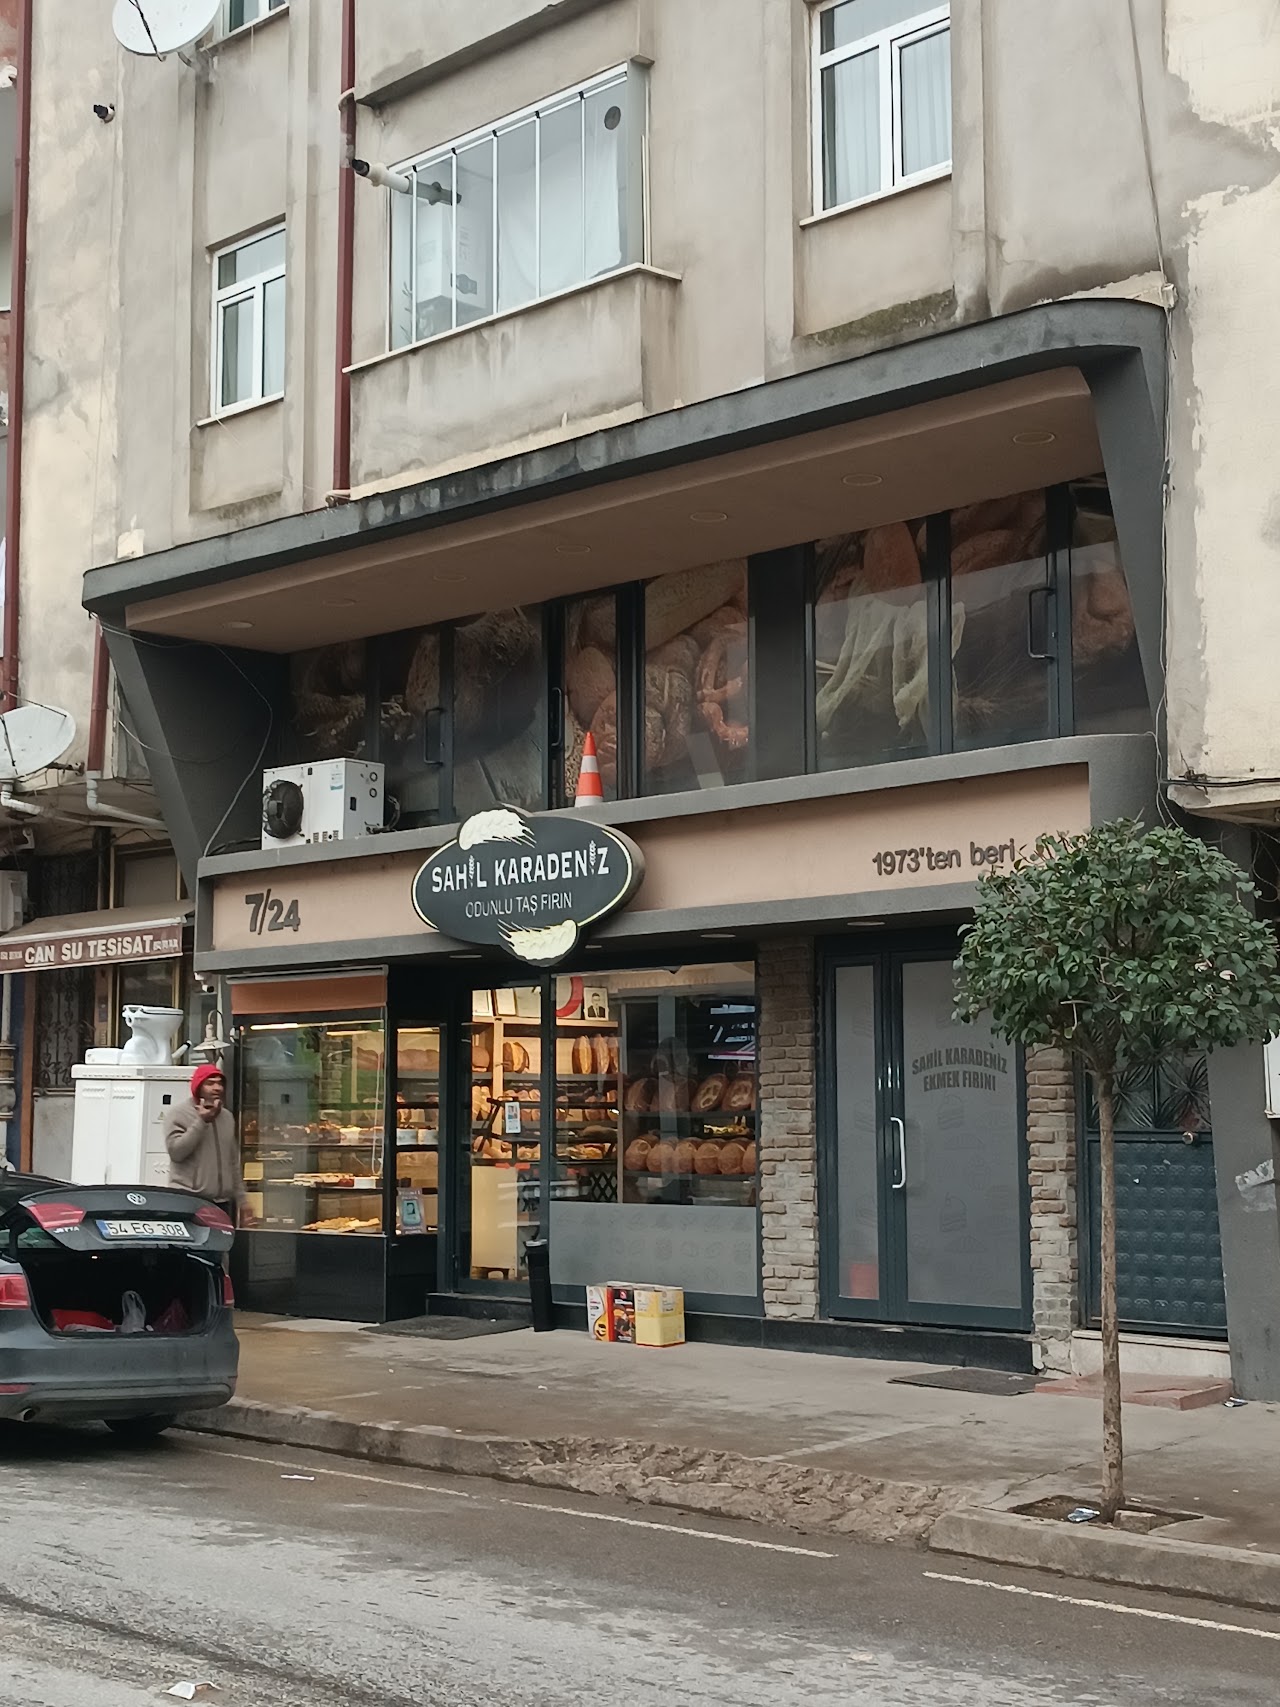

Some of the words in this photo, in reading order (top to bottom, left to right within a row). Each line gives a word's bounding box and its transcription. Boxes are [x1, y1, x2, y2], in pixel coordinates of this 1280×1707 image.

[494, 840, 610, 886] KARADENİZ
[872, 846, 961, 876] 1973'ten
[970, 838, 1015, 866] beri
[245, 888, 301, 935] 7/24
[465, 898, 513, 918] ODUNLU
[515, 894, 538, 916] TAŞ
[540, 892, 573, 911] FIRIN
[24, 945, 55, 964] CAN
[61, 942, 83, 962] SU
[912, 1048, 943, 1075] SAHİL
[945, 1047, 1008, 1074] KARADENİZ
[923, 1070, 960, 1092] EKMEK
[962, 1070, 996, 1091] FIRINI
[107, 1222, 127, 1235] 54
[131, 1222, 154, 1235] EG
[157, 1223, 185, 1236] 308
